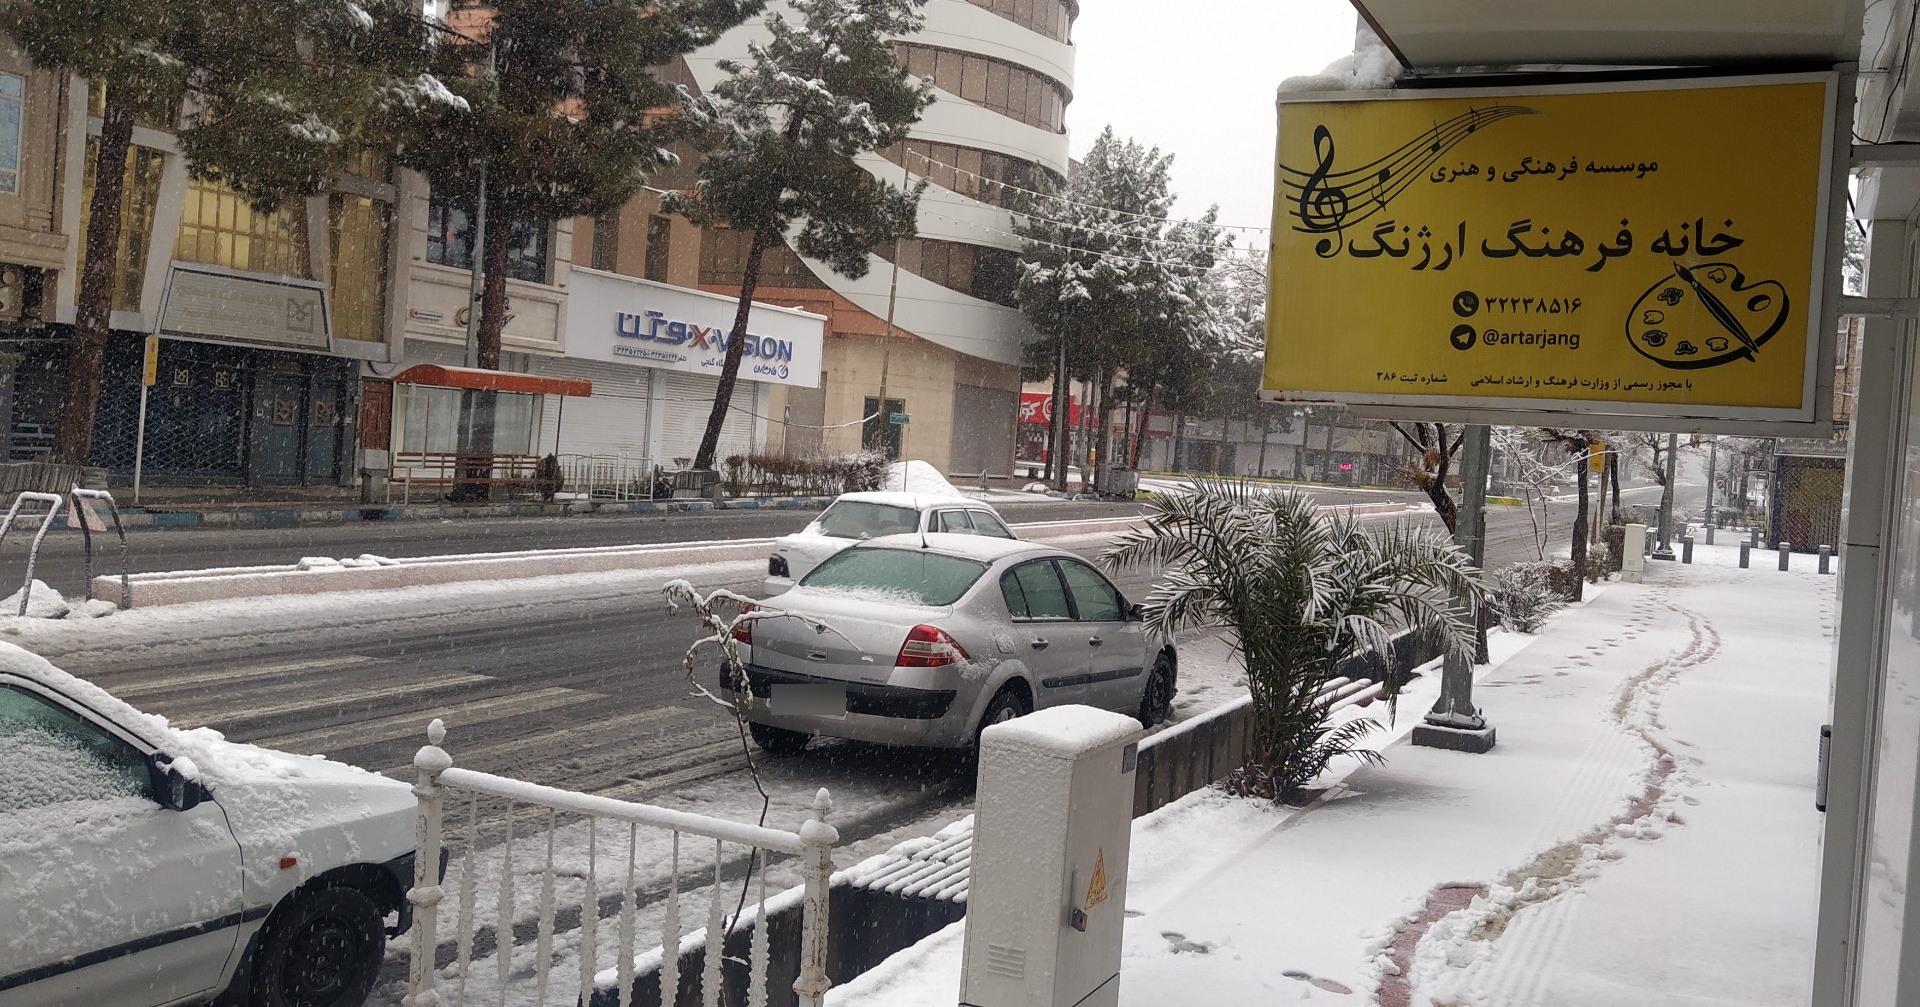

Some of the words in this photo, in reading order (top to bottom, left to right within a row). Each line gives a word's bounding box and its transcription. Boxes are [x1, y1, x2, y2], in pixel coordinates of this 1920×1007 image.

[1430, 161, 1480, 183] هنری
[1485, 165, 1496, 182] و
[1502, 155, 1578, 183] فرهنگی
[1585, 160, 1659, 179] موسسه
[1650, 216, 1746, 257] خانه
[1346, 217, 1467, 271] ارژنگ
[1481, 218, 1633, 273] فرهنگ
[1484, 297, 1582, 315] ۳۲۲۳۸۵۱۶
[1482, 328, 1581, 350] @artarjang
[1376, 371, 1397, 382] ۳۸۶
[1399, 373, 1419, 385] ثبت
[1420, 373, 1448, 386] شماره
[1470, 375, 1504, 387] اسلامی
[1505, 375, 1533, 388] ارشاد
[1542, 375, 1578, 390] فرهنگ
[1534, 379, 1540, 389] و
[1580, 377, 1610, 391] وزارت
[1612, 377, 1621, 391] از
[1623, 382, 1654, 391] رسمی
[1656, 380, 1683, 392] مجوز
[1685, 378, 1693, 392] با
